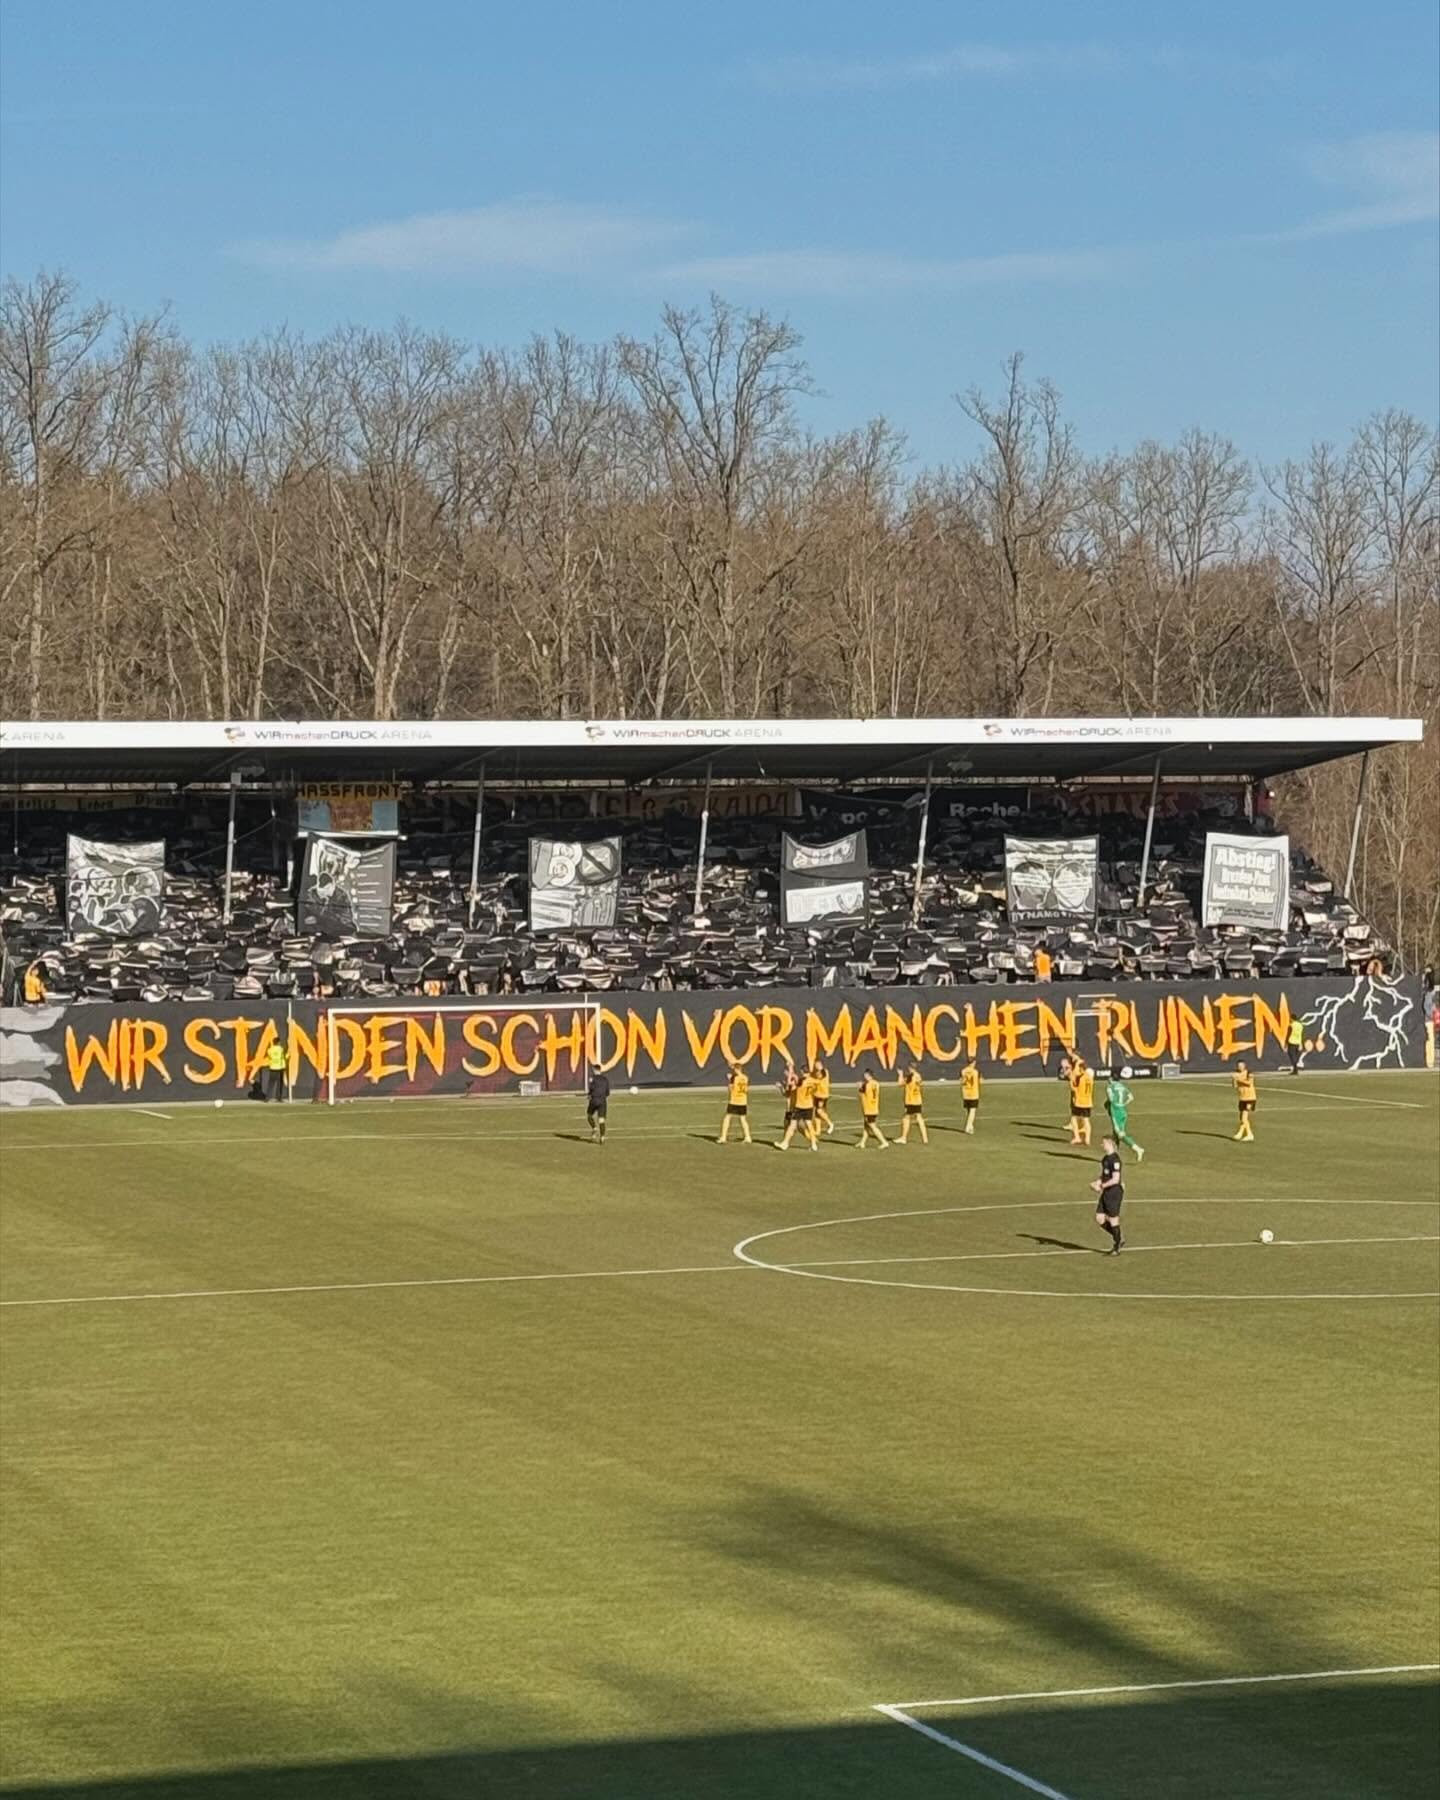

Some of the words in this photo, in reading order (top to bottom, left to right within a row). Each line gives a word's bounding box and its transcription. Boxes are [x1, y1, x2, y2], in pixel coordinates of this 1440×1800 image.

[11, 731, 65, 741] ARENA
[254, 729, 378, 740] WIRmachenDRUCK
[381, 729, 432, 739] ARENA
[612, 728, 731, 738] WIRmachenDRUCK
[734, 727, 783, 738] ARENA
[1010, 726, 1123, 737] WIRmachenDRUCK
[1126, 726, 1172, 737] ARENA
[296, 783, 400, 799] HASSFRONT
[66, 1018, 172, 1092] WIR
[184, 1013, 445, 1088] STANDEN
[462, 1006, 667, 1082] SCHON
[682, 1004, 795, 1074] VOR
[806, 996, 1075, 1072] MANCHEN
